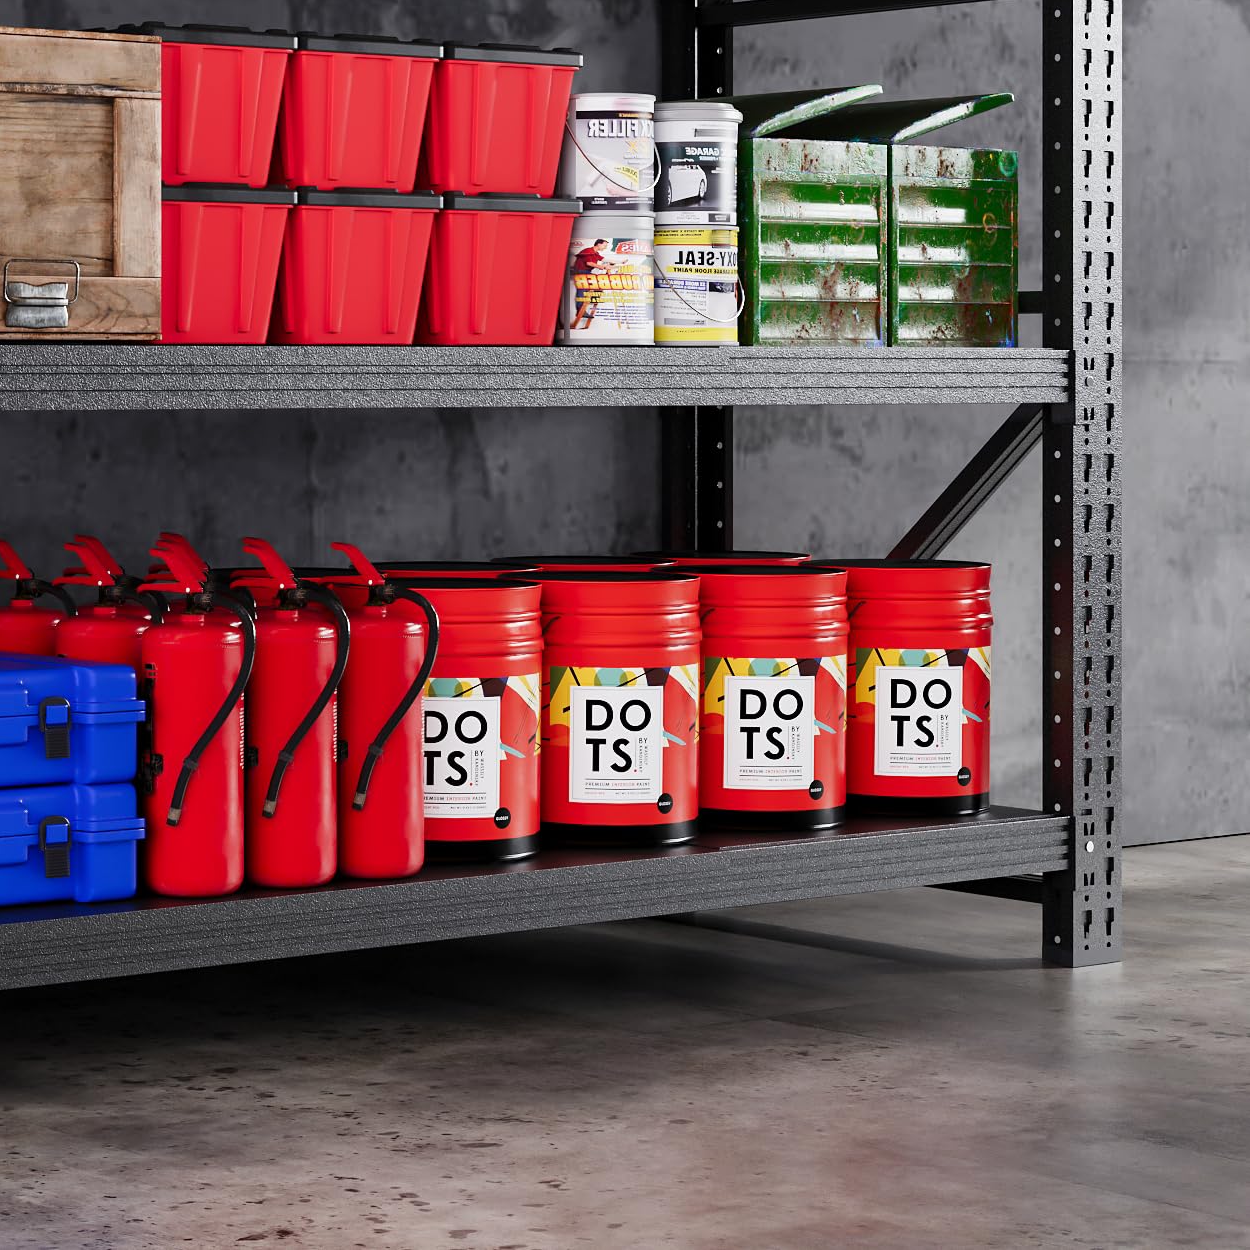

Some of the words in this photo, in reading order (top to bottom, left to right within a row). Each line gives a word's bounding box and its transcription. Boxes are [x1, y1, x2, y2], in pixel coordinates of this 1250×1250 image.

[740, 689, 803, 720] DO
[891, 679, 952, 709] DO
[424, 710, 487, 744] DO
[586, 699, 651, 731] DO
